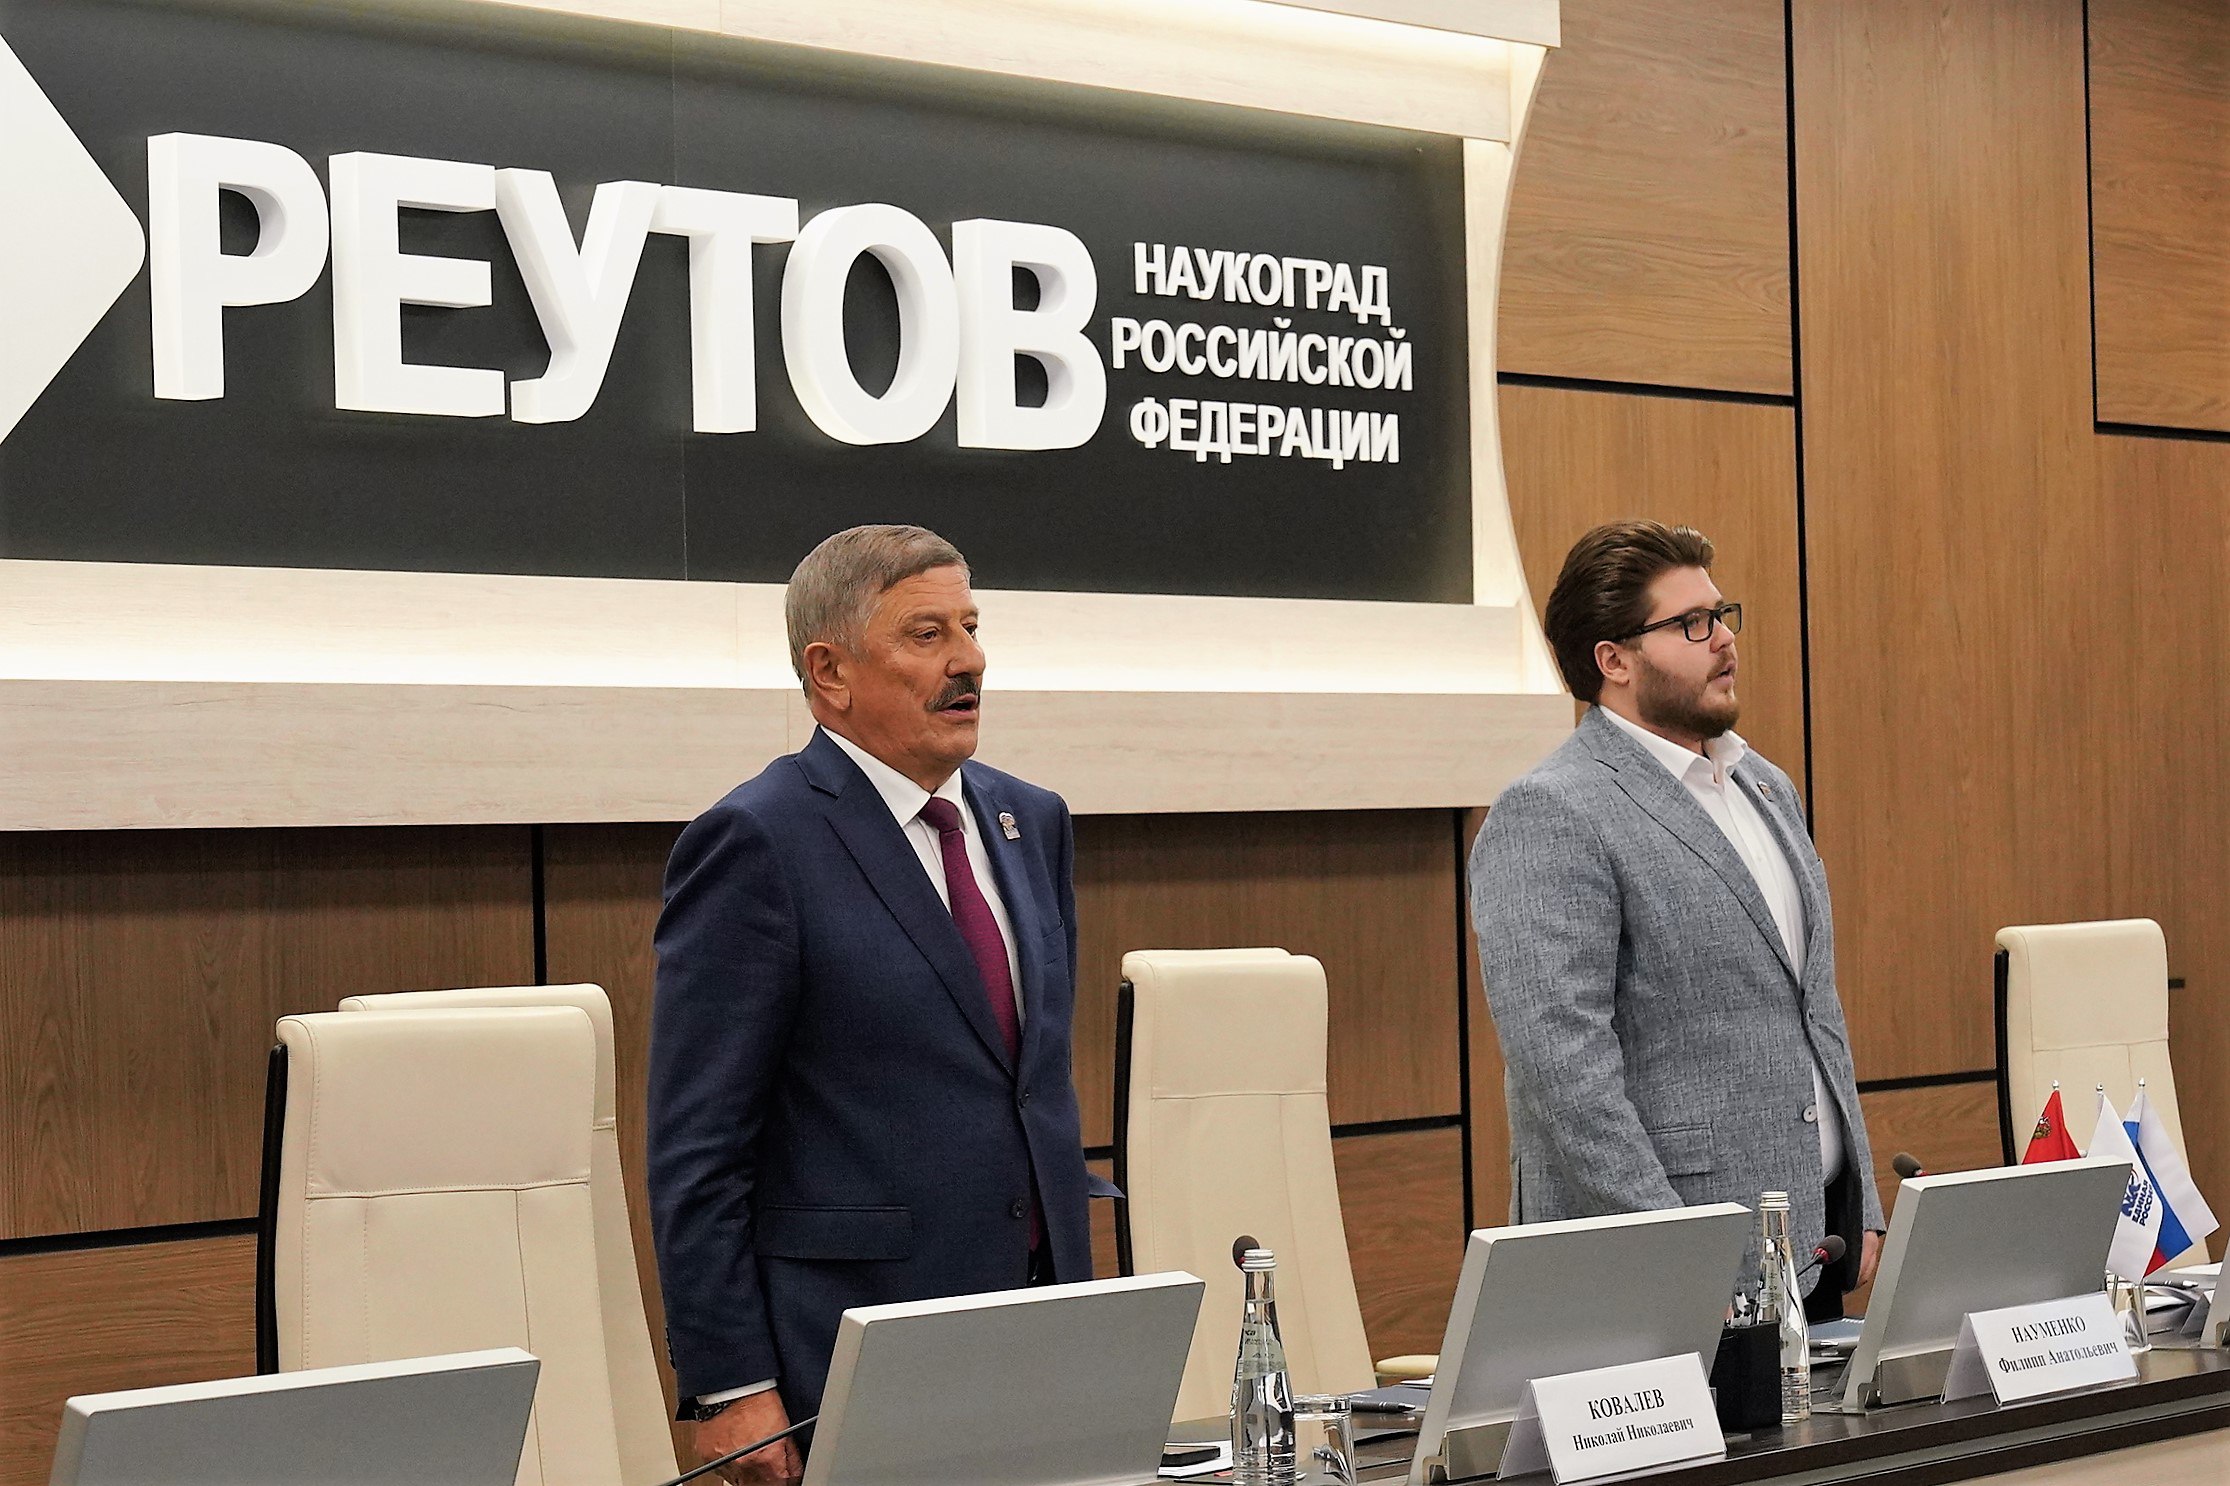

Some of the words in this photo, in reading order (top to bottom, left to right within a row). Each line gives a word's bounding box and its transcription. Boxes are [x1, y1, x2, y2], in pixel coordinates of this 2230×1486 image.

[147, 131, 1107, 450] РЕУТОВ
[1134, 242, 1391, 326] НАУКОГРАД
[1111, 316, 1413, 391] РОССИЙСКОЙ
[1129, 397, 1400, 470] ФЕДЕРАЦИИ
[2131, 1179, 2149, 1223] ЕДИНАЯ
[2011, 1316, 2086, 1343] НАУМЕНКО
[1998, 1354, 2047, 1373] Филипп
[2048, 1341, 2119, 1365] Анатольевич
[1587, 1388, 1665, 1420] КОВАЛЕВ
[1572, 1427, 1626, 1451] Николай
[1626, 1418, 1694, 1441] Николаевич
